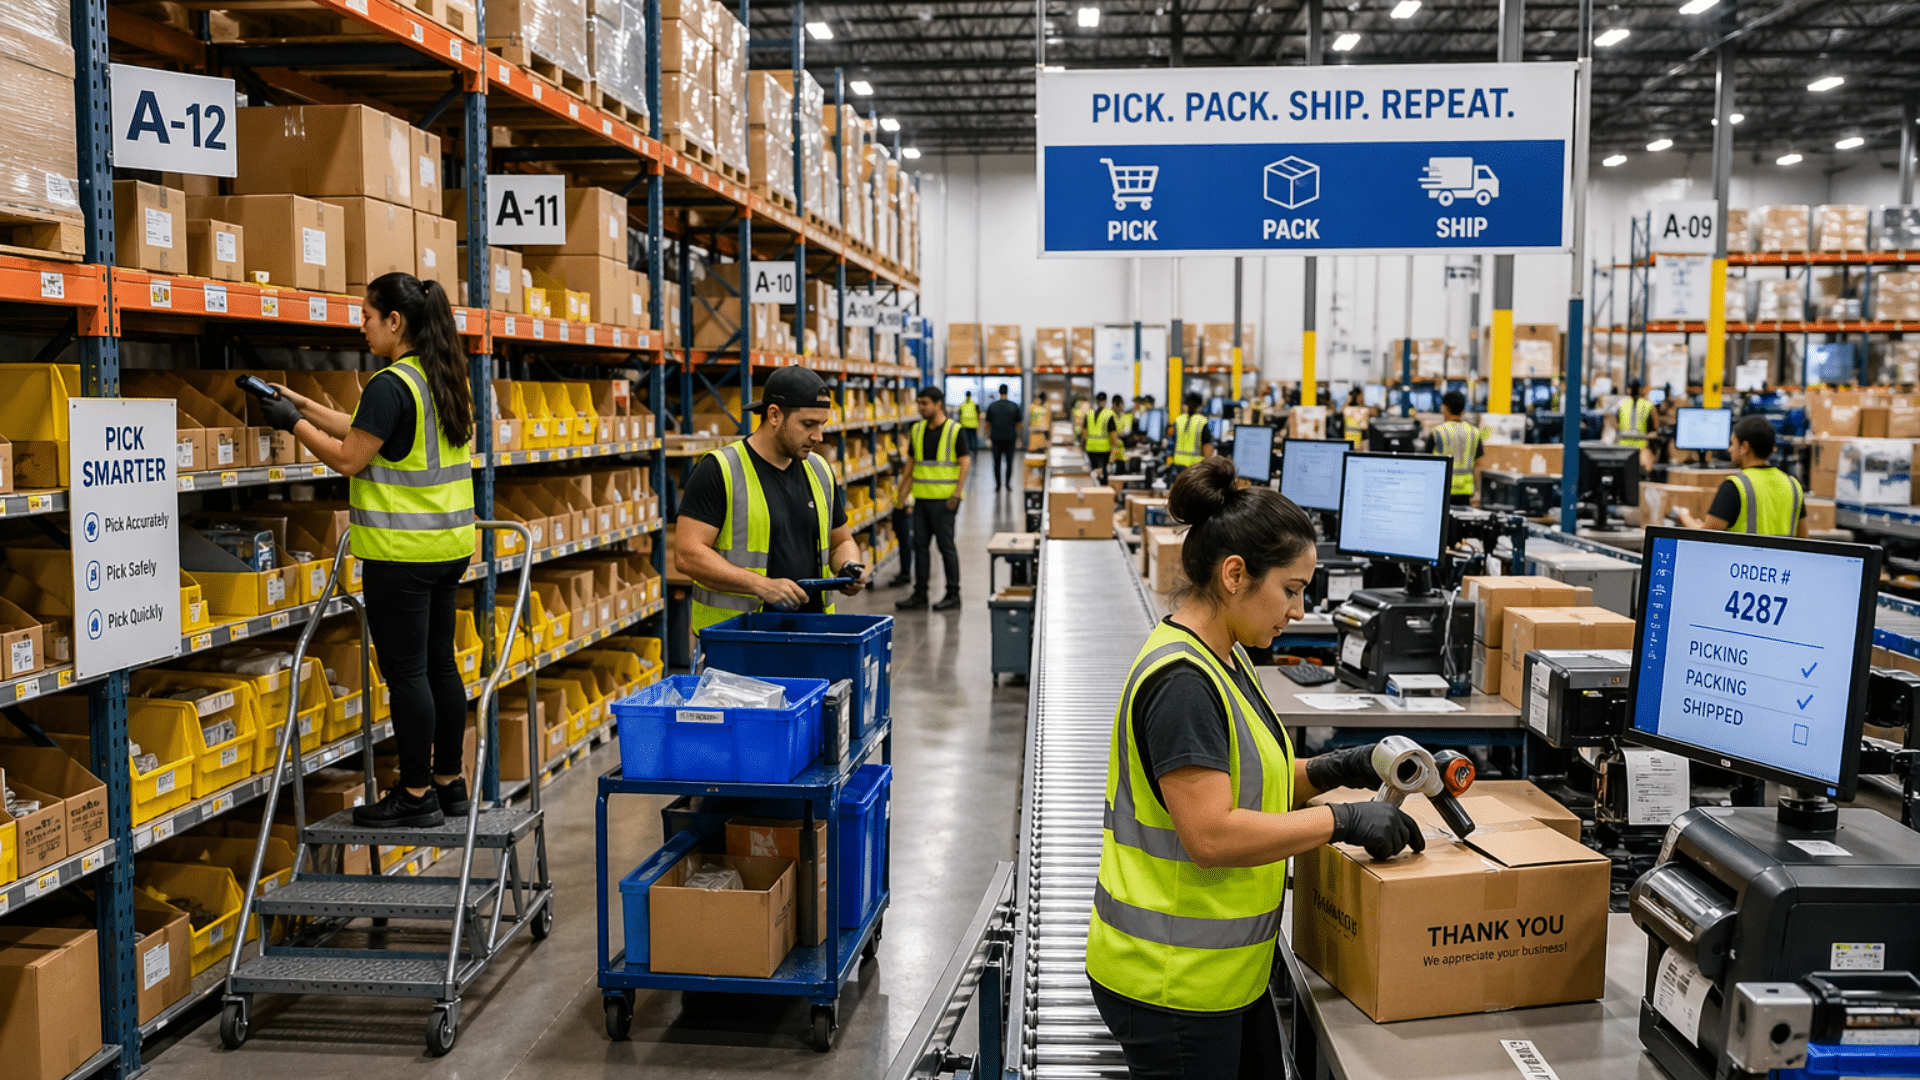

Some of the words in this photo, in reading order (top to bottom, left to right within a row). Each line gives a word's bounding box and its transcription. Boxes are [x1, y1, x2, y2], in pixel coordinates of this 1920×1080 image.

[1092, 92, 1173, 123] PICK.
[1185, 91, 1279, 122] PACK.
[1289, 89, 1370, 121] SHIP.
[1382, 87, 1515, 120] REPEAT.
[125, 89, 227, 151] A-12
[495, 190, 558, 227] A-11
[1107, 219, 1158, 242] PICK
[1262, 218, 1321, 240] PACK
[1436, 216, 1488, 238] SHIP
[1663, 213, 1712, 239] A-09
[755, 271, 793, 293] A-10
[105, 426, 145, 451] PICK
[82, 457, 166, 488] SMARTER
[104, 517, 125, 534] Pick
[126, 511, 170, 531] Accurately
[106, 564, 128, 581] Pick
[128, 558, 157, 579] Safely
[1730, 562, 1777, 584] ORDER
[1781, 569, 1791, 585] #
[108, 610, 129, 629] Pick
[130, 603, 164, 627] Quickly
[1724, 590, 1788, 626] 4287
[1689, 640, 1749, 666] PICKING
[1685, 668, 1747, 696] PACKING
[1683, 697, 1744, 726] SHIPPED
[1427, 919, 1510, 947] THANK
[1516, 914, 1565, 938] YOU
[1423, 955, 1440, 967] We
[1442, 949, 1495, 966] appreciate
[1497, 948, 1520, 961] your
[1521, 942, 1568, 956] business!
